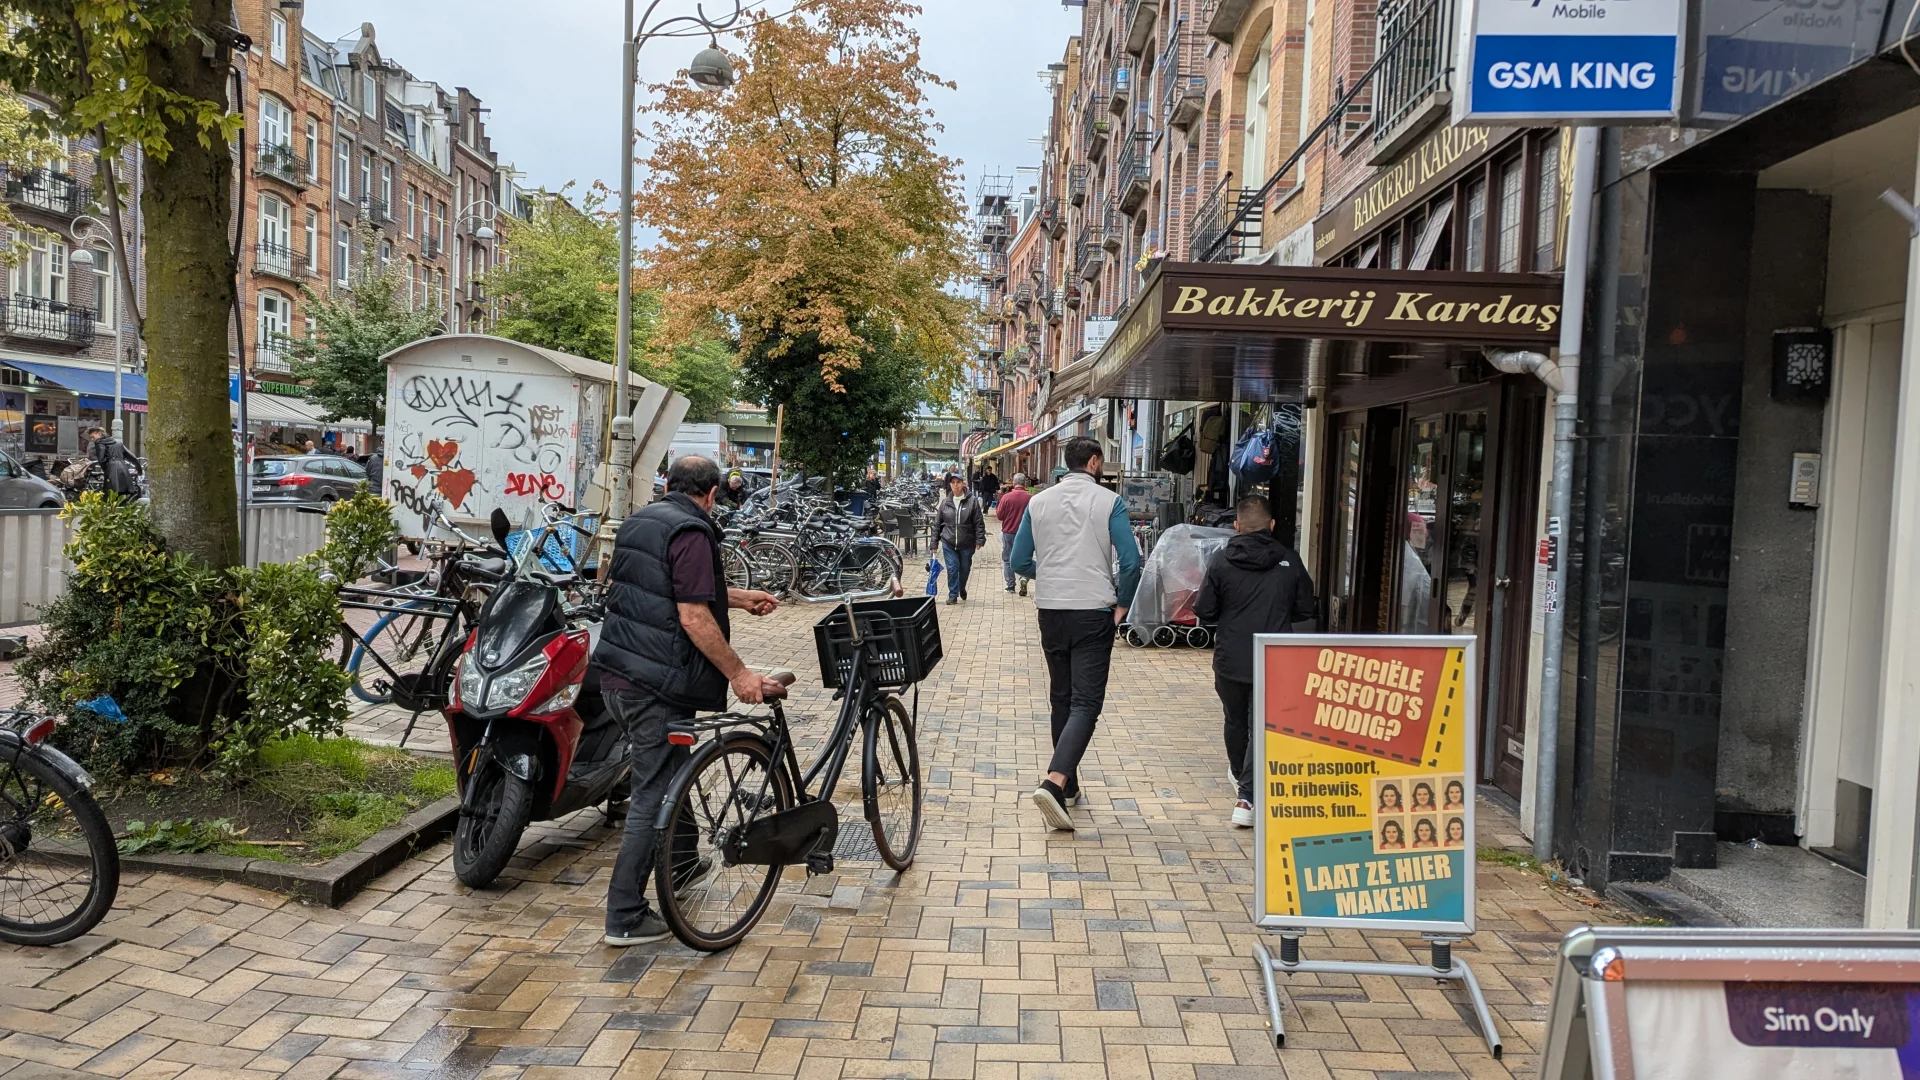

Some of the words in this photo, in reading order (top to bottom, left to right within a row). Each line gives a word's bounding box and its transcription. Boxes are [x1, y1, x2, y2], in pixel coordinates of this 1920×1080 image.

[1552, 5, 1606, 19] Mobile
[1488, 61, 1562, 89] GSM
[1570, 62, 1656, 89] KING
[1353, 156, 1417, 232] BAKKERIJ
[1166, 286, 1377, 327] Bakkerij
[1384, 291, 1561, 332] Kardaş
[261, 380, 303, 396] SUPERMAR
[1317, 648, 1424, 693] OFFICIËLE
[1314, 703, 1402, 742] NODIG?
[1269, 760, 1304, 776] Voor
[1307, 760, 1380, 776] paspoort,
[1270, 782, 1289, 798] ID,
[1292, 781, 1362, 798] rijbewijs,
[1271, 804, 1328, 819] visums,
[1331, 803, 1367, 818] fun...
[1304, 863, 1360, 892] LAAT
[1365, 860, 1393, 885] ZE
[1395, 854, 1452, 882] HIER
[1335, 885, 1428, 917] MAKEN!
[1763, 1007, 1810, 1032] Sim
[1814, 1007, 1875, 1038] Only
